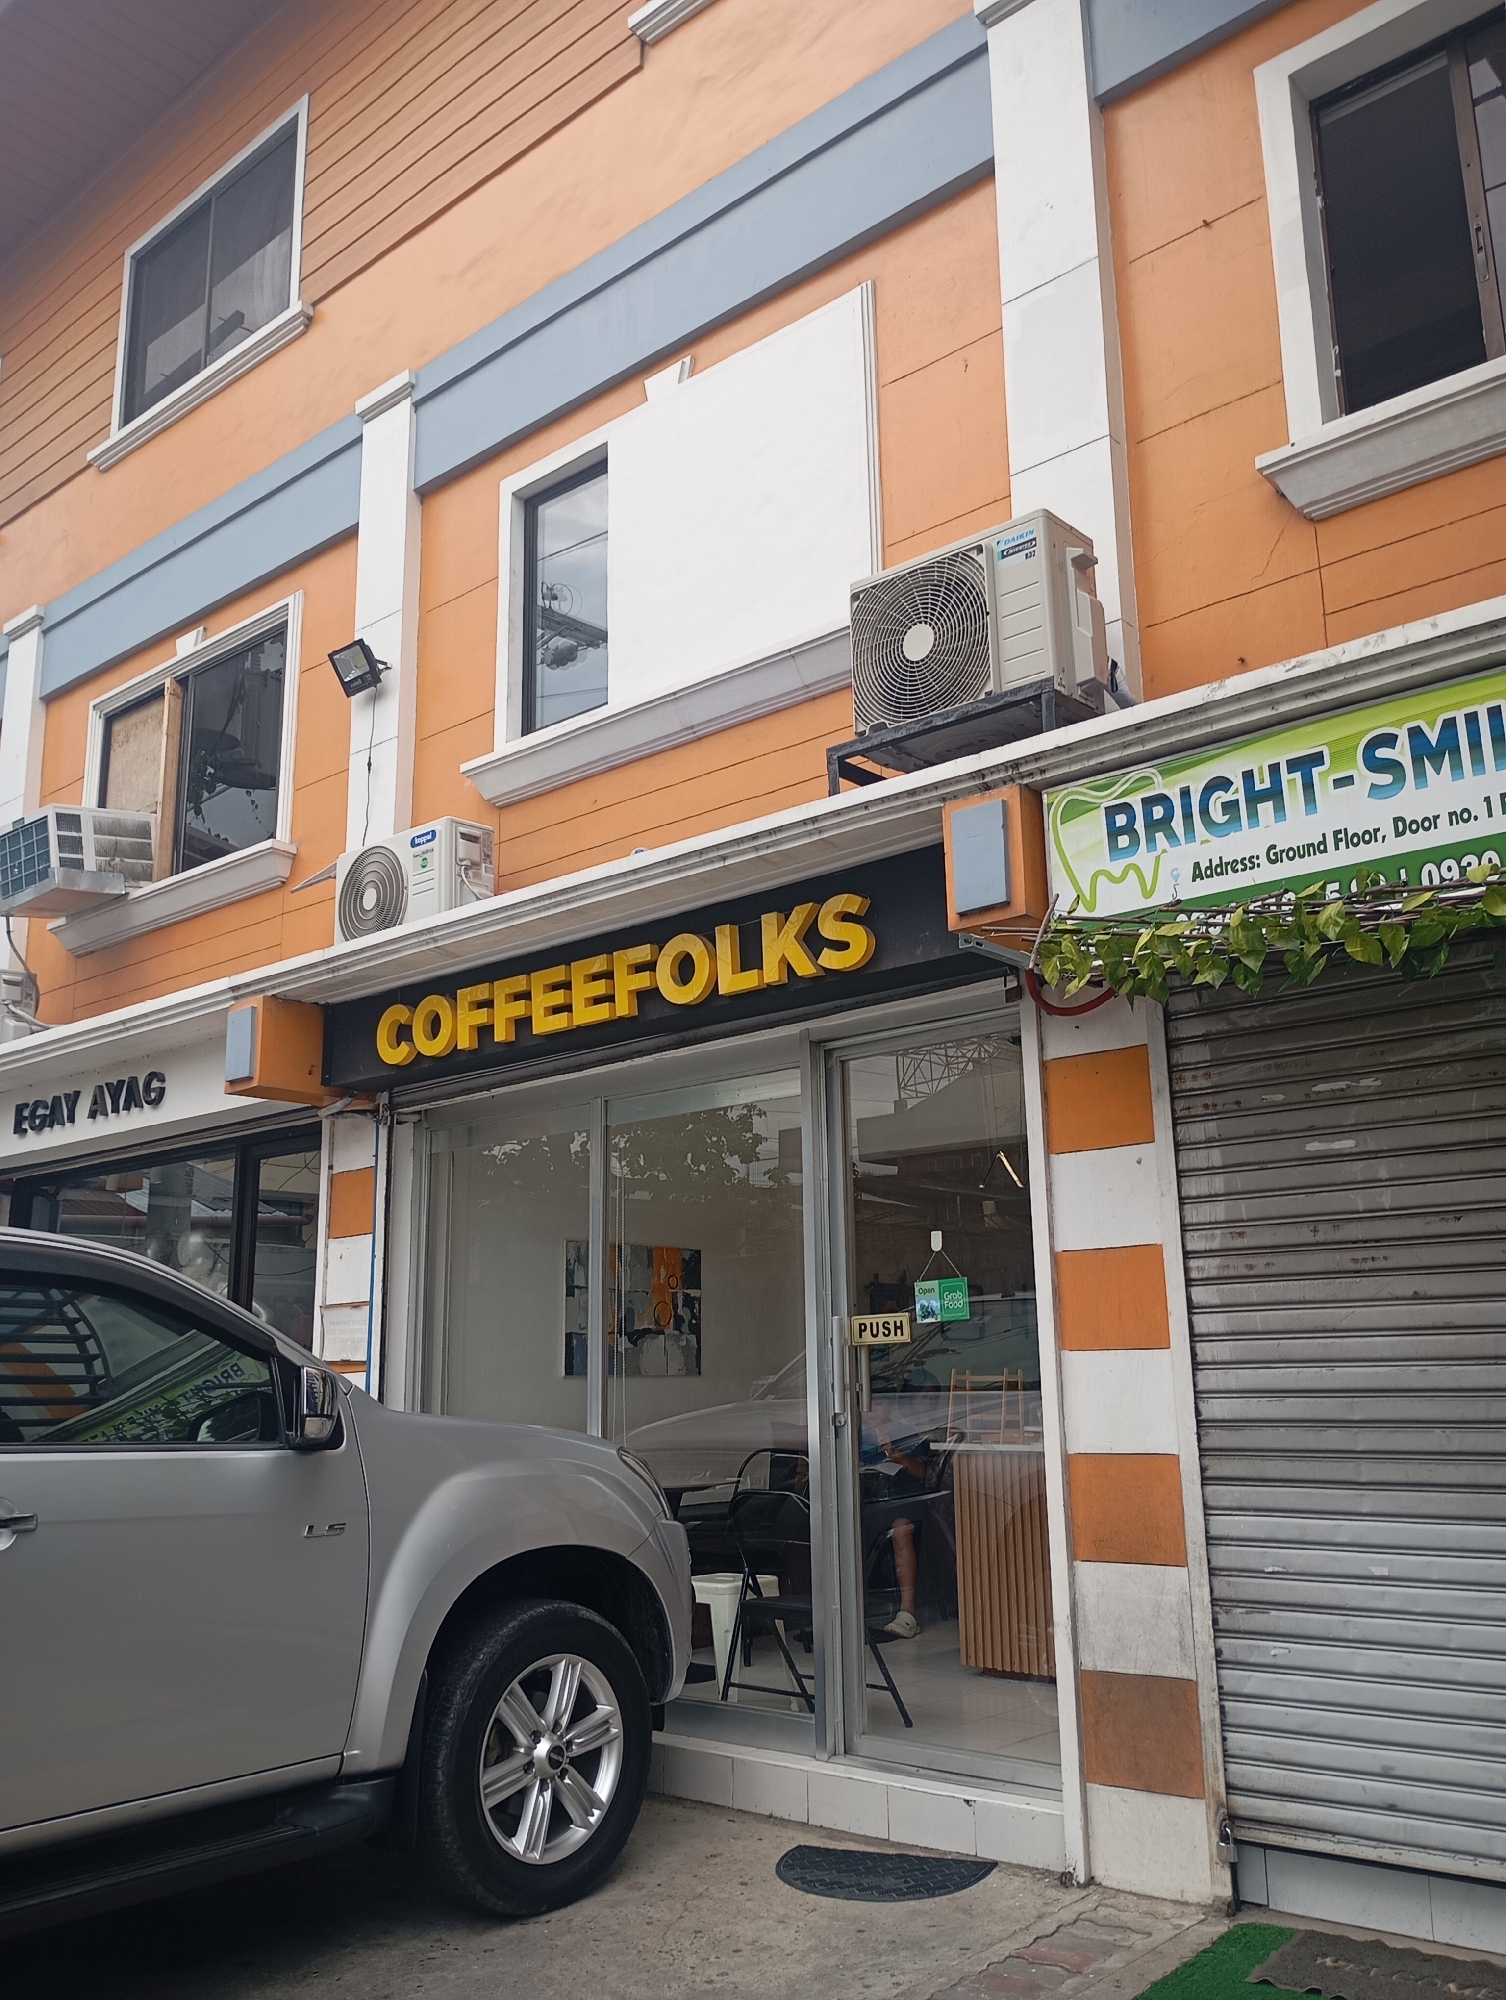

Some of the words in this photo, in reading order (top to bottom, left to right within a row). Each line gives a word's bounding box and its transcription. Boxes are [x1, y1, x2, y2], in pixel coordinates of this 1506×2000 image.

[1004, 528, 1035, 545] DAIKIN
[1191, 853, 1261, 882] Address:
[1266, 833, 1328, 864] Ground
[1332, 826, 1387, 851] Floor,
[1392, 813, 1440, 838] Door
[1447, 808, 1478, 826] no.
[1483, 796, 1493, 818] 1
[376, 893, 876, 1066] COFFEEFOLKS
[13, 1090, 81, 1134] EGAY
[87, 1071, 166, 1119] AYAG
[918, 1287, 935, 1296] Open
[943, 1290, 963, 1301] Grab
[944, 1299, 964, 1310] Food
[858, 1320, 904, 1339] PUSH
[303, 1522, 346, 1538] LS
